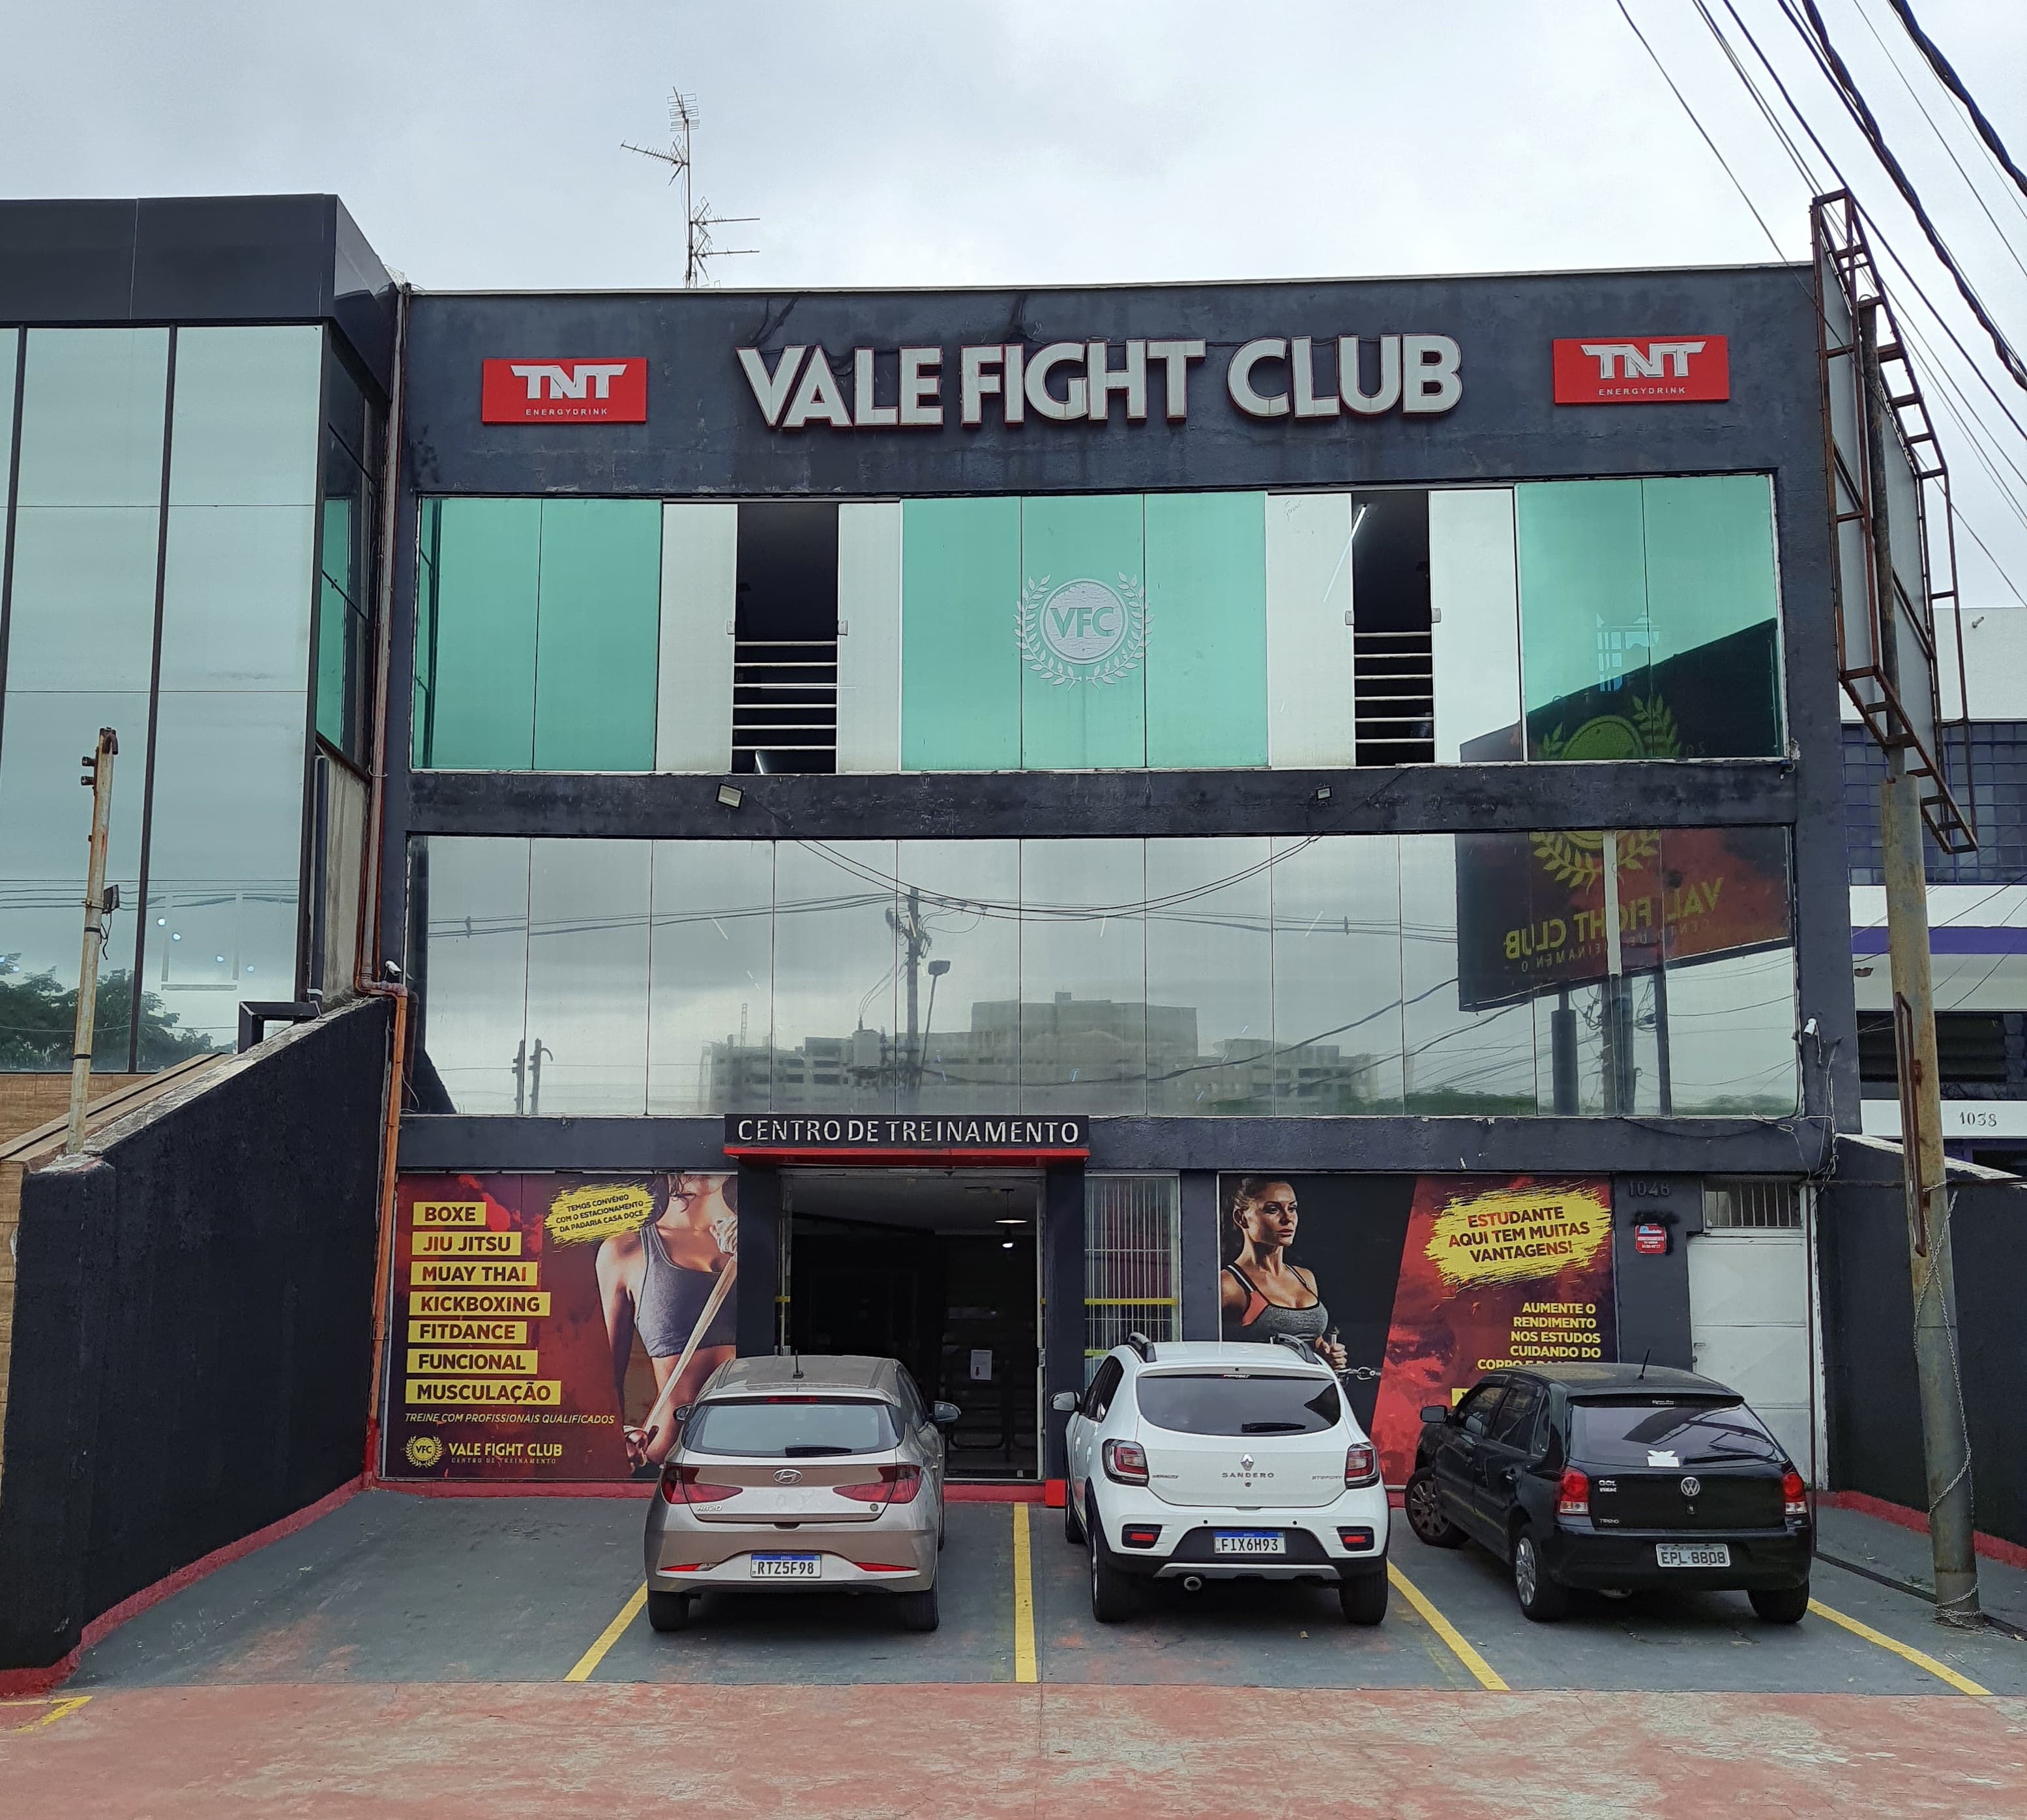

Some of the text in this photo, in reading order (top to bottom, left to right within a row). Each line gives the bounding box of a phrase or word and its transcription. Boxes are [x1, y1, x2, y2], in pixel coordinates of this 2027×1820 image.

[1580, 341, 1706, 379] TNT
[510, 364, 628, 399] TNT
[735, 333, 1463, 428] VALE FIGHT CLUB
[1049, 606, 1116, 638] VFC
[1959, 1111, 1997, 1127] 1038
[738, 1119, 1079, 1143] CENTRO DE TREINAMENTO
[1629, 1180, 1669, 1196] 1046
[567, 1193, 629, 1212] TEMOS CONVÊNIO
[424, 1207, 476, 1222] BOXE
[555, 1215, 572, 1224] COM
[580, 1200, 644, 1219] ESTACIONAMENTO
[1468, 1206, 1565, 1229] ESTUDANTE
[559, 1210, 644, 1233] DA PADARIA CASA DOCE
[1449, 1221, 1590, 1248] AQUI TEM MUITAS
[422, 1236, 510, 1252] JIU JITSU
[1470, 1240, 1573, 1263] VANTAGENS!
[422, 1266, 526, 1282] MUAY THAI
[421, 1296, 540, 1312] KICKBOXING
[1522, 1302, 1596, 1314] AUMENTE O
[1513, 1317, 1596, 1328] RENDIMENTO
[419, 1323, 516, 1340] FITDANCE
[1511, 1331, 1601, 1344] NOS ESTUDOS
[1509, 1345, 1601, 1358] CUIDANDO DO
[418, 1353, 526, 1370] FUNCIONAL
[417, 1381, 551, 1403] MUSCULAÇÃO
[405, 1413, 615, 1425] TREINE COM PROFISSIONAIS QUALIFICADOS
[415, 1445, 432, 1454] VFC
[449, 1443, 563, 1458] VALE FIGHT CLUB
[1221, 1538, 1278, 1551] FIX6H93
[758, 1561, 814, 1574] RTZ5F98
